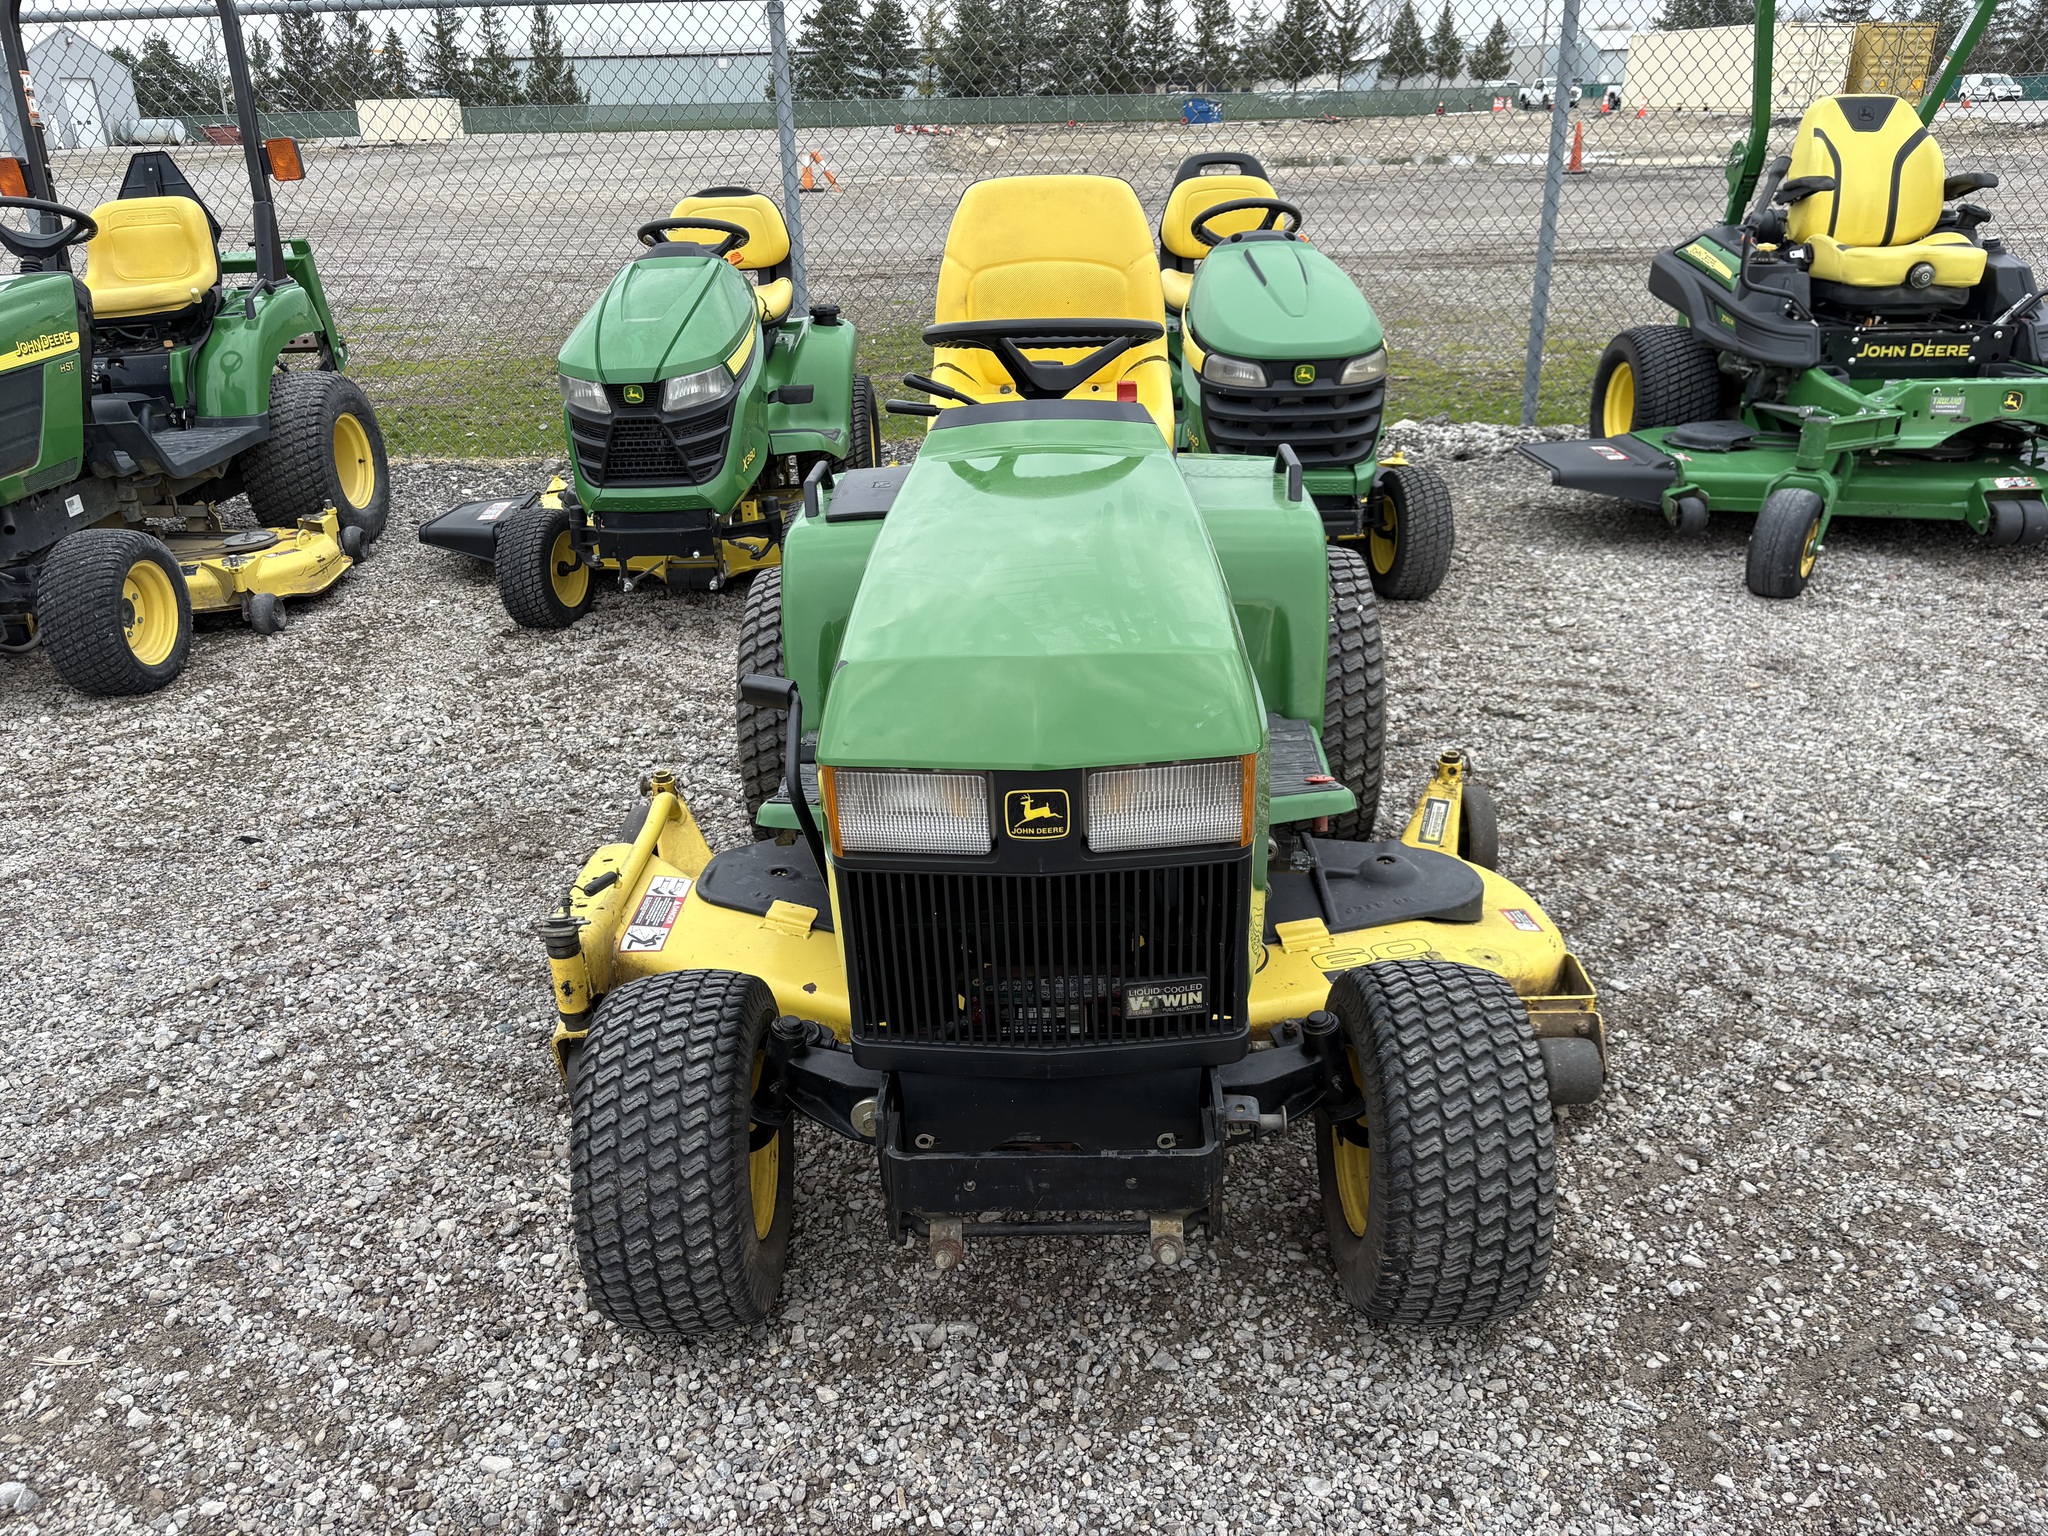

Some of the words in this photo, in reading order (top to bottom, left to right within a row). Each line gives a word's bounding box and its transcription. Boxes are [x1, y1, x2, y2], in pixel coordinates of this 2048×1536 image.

[16, 339, 43, 357] JOHN
[40, 331, 73, 350] DEERE
[1856, 343, 1907, 358] JOHN
[1909, 343, 1971, 358] DEERE
[60, 361, 74, 373] HST
[742, 447, 755, 472] X380
[1011, 827, 1035, 835] JOHN
[1036, 826, 1065, 834] DEERE
[1311, 938, 1433, 969] 60
[1127, 991, 1203, 1011] V-TWIN
